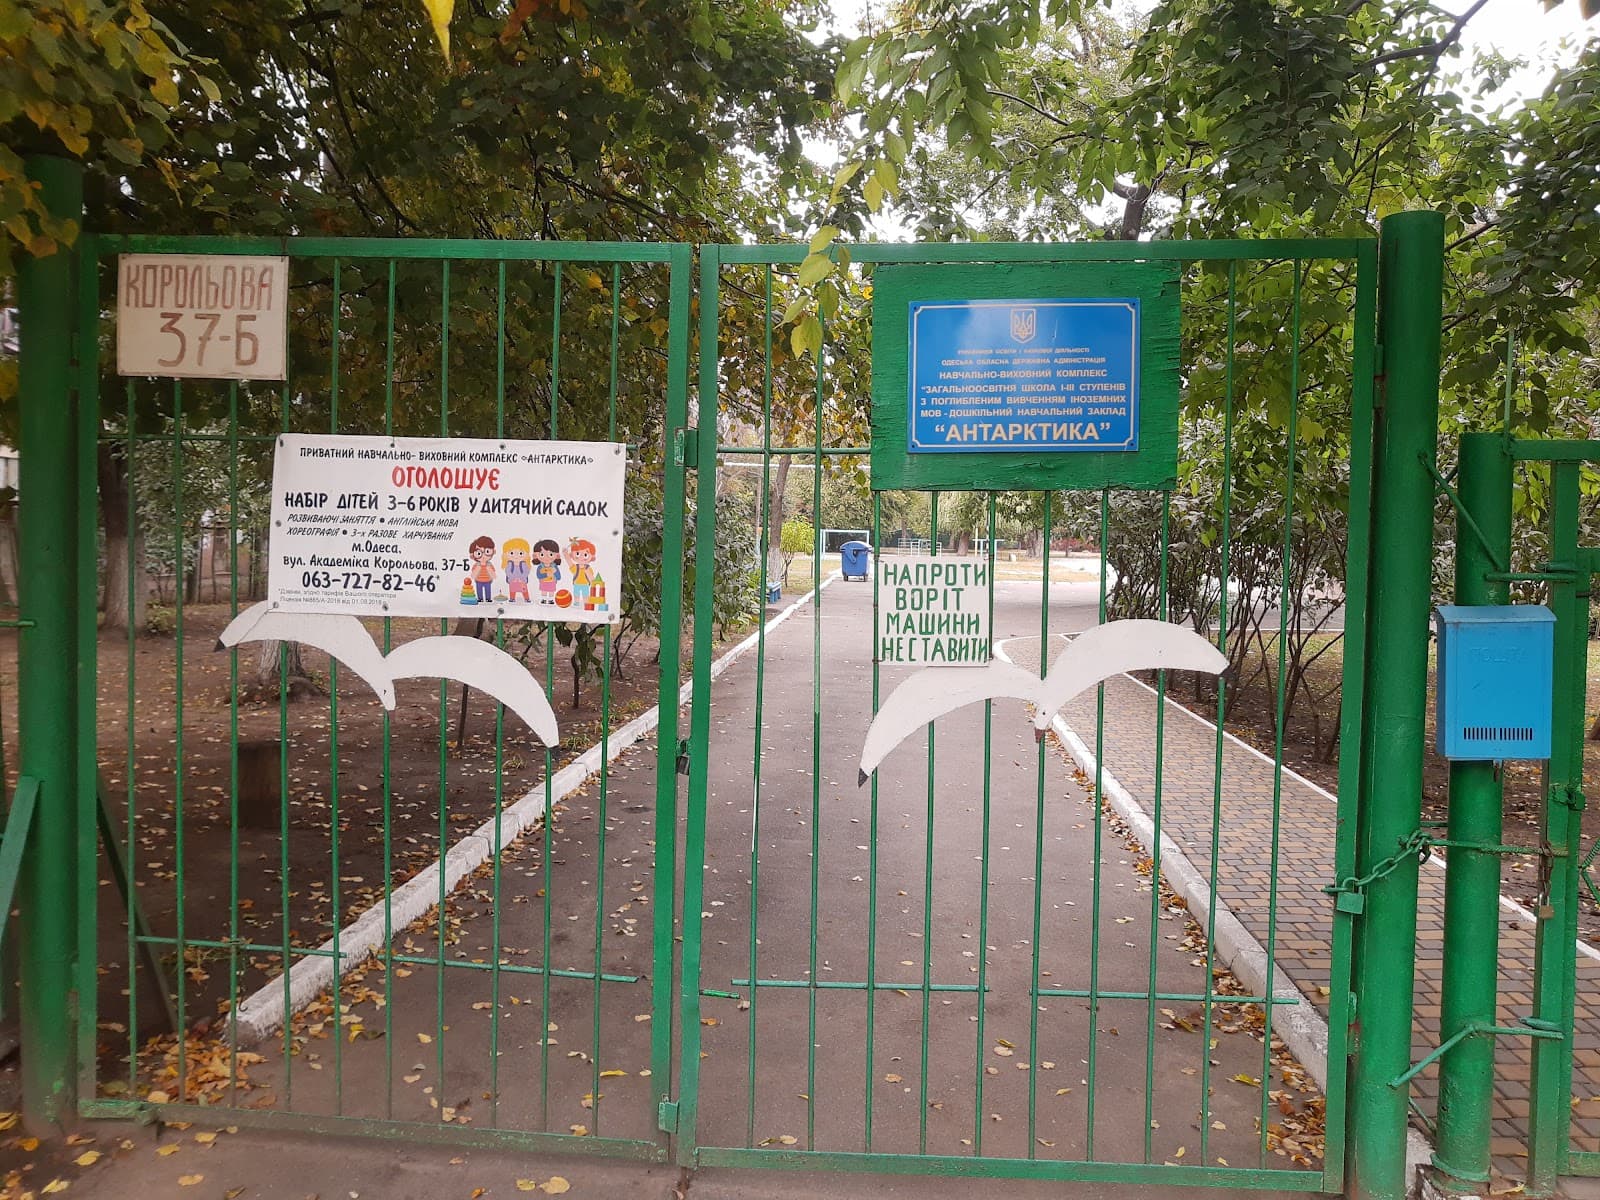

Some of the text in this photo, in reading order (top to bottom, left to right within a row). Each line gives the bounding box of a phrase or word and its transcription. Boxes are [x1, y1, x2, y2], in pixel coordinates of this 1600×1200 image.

[126, 264, 273, 310] КОРОЛЬОВА
[158, 312, 259, 367] 37-Б
[940, 369, 1051, 379] НАВЧАЛЬНО-ВИХОВНИЙ
[1080, 383, 1126, 391] СТУПЕНІВ
[931, 397, 1001, 405] ПОГЛИБЛЕНИМ
[1007, 396, 1065, 404] ВИВЧЕННЯМ
[949, 408, 1012, 418] ДОШКІЛЬНИЙ
[1018, 407, 1082, 416] НАВЧАЛЬНИЙ
[1088, 408, 1126, 416] ЗАКЛАД
[300, 448, 354, 458] ПРИВАТНИЙ
[419, 451, 466, 462] ВИХОВНИЙ
[469, 452, 518, 463] КОМПЛЕКС
[392, 465, 500, 491] ОГОЛОШУЄ
[285, 492, 608, 517] НАБІР ДІТЕЙ 3-6 РОКІВ У ДИТЯЧИЙ САДОК
[288, 514, 458, 528] РОЗВИВАЮЧІ ЗАНЯТТЯ АНГЛІЙСЬКА МОВА
[287, 527, 340, 537] ХОРЕОГРАФІЯ
[368, 529, 398, 538] РАЗОВЕ
[402, 530, 453, 541] ХАРЧУВАННЯ
[283, 556, 306, 568] вул.
[310, 554, 369, 568] Академіка
[442, 558, 470, 572] 37-Б
[884, 563, 986, 586] НАПРОТИ
[896, 588, 964, 610] ВОРІТ
[886, 612, 980, 635] МАШИНИ
